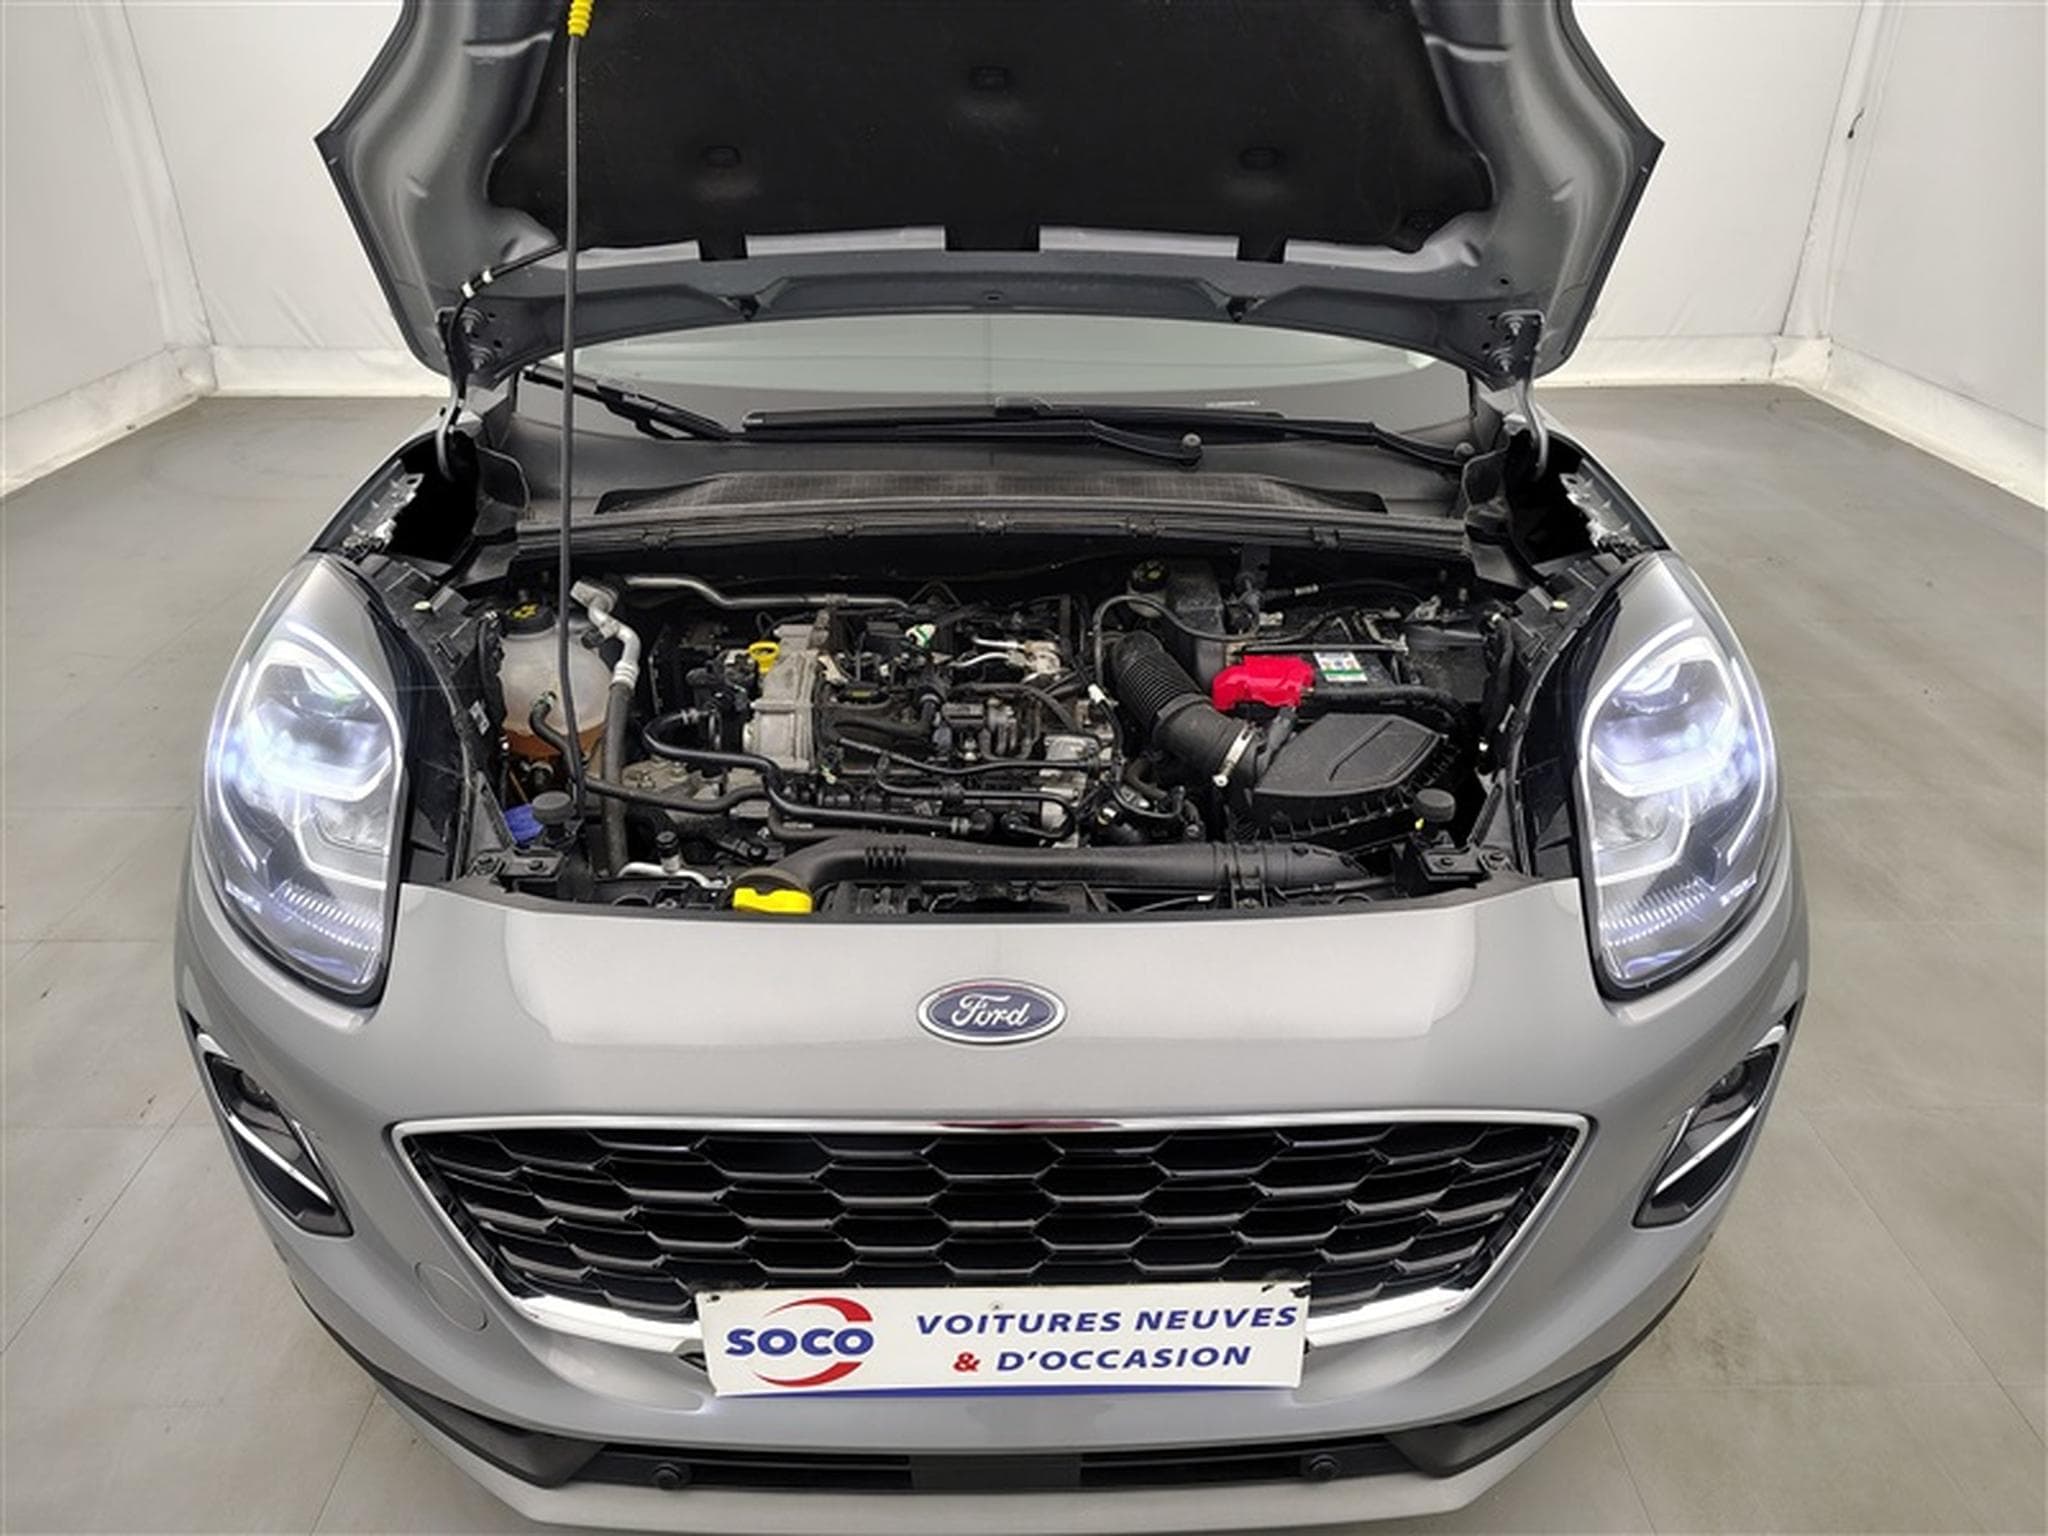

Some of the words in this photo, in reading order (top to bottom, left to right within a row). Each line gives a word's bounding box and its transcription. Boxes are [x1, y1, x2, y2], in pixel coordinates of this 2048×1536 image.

[952, 992, 1030, 1026] Ford
[916, 1312, 1121, 1335] VOITURES
[1134, 1306, 1298, 1331] NEUVES
[725, 1328, 874, 1356] SOCO
[953, 1352, 979, 1372] &
